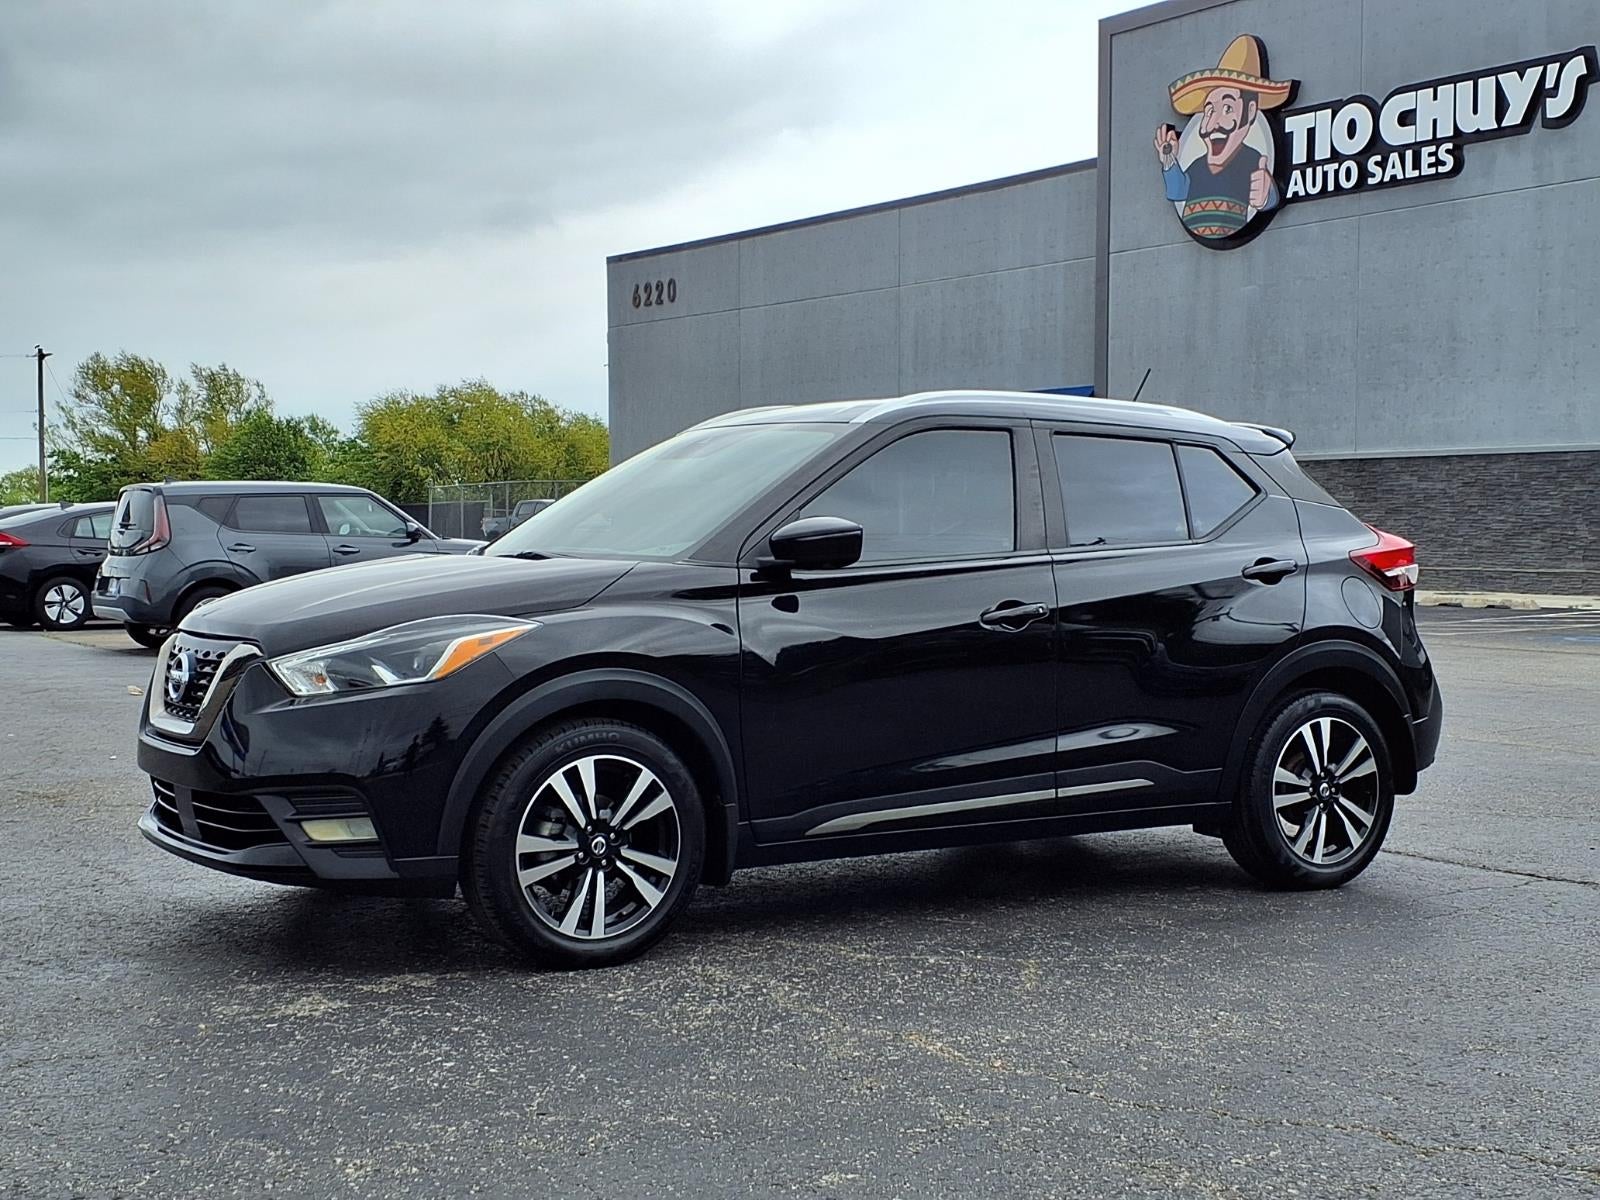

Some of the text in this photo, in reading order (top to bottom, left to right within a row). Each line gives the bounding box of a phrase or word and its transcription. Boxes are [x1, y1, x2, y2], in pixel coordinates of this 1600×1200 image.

[1285, 55, 1587, 163] TIO CHUY'S
[1286, 143, 1455, 199] AUTO SALES
[632, 278, 677, 309] 6220
